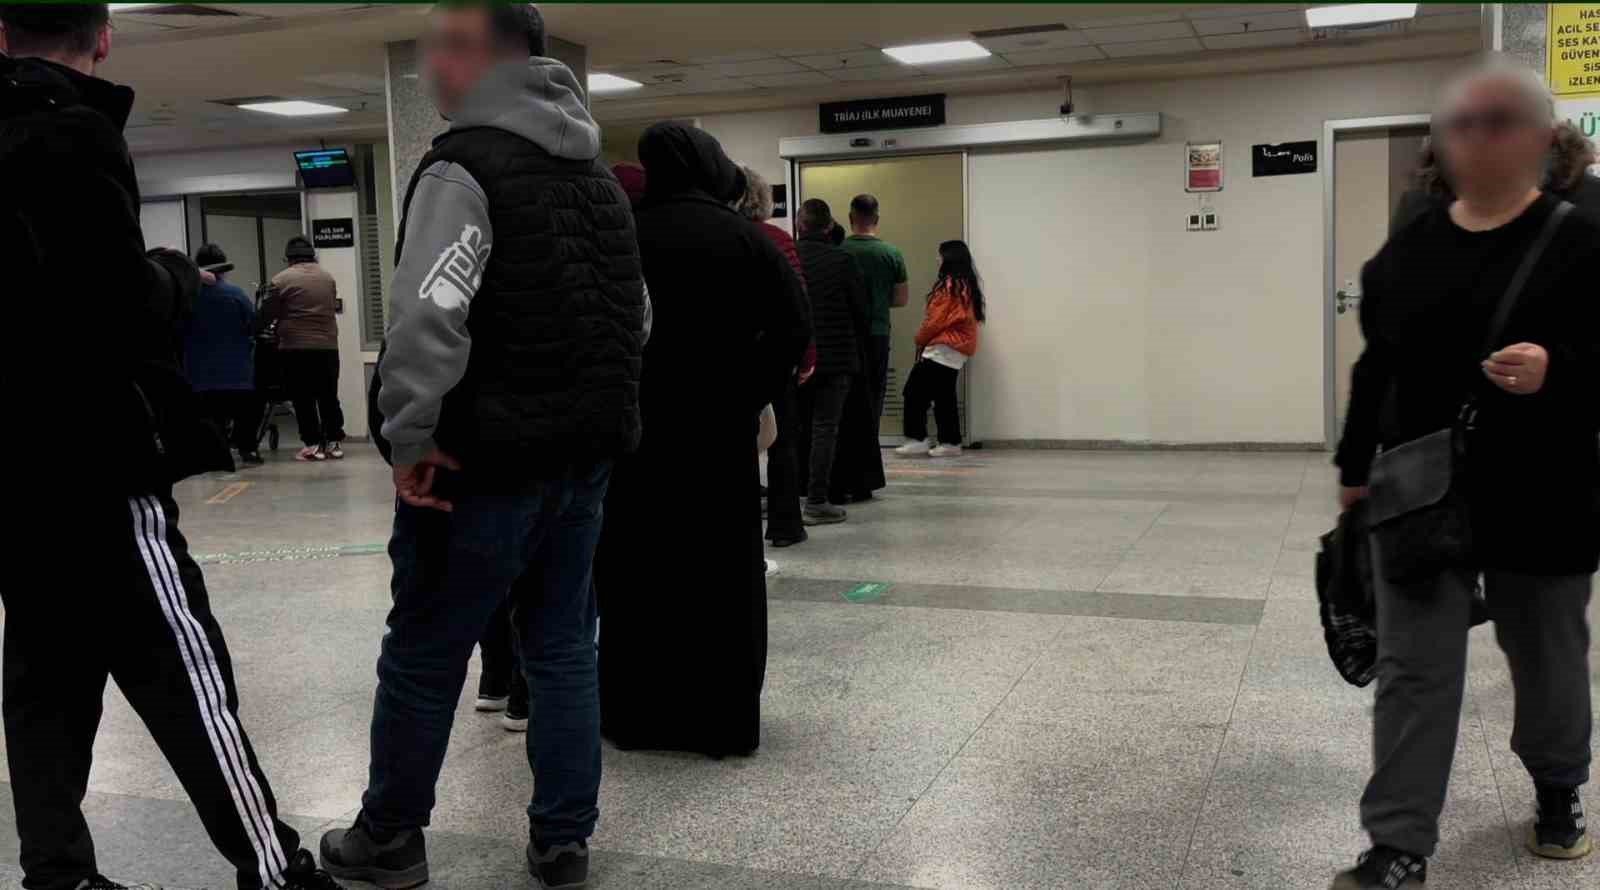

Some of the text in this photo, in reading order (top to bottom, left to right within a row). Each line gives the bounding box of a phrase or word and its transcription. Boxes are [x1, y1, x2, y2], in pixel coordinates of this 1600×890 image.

[1558, 36, 1600, 48] SES KA
[1292, 152, 1315, 162] Polis
